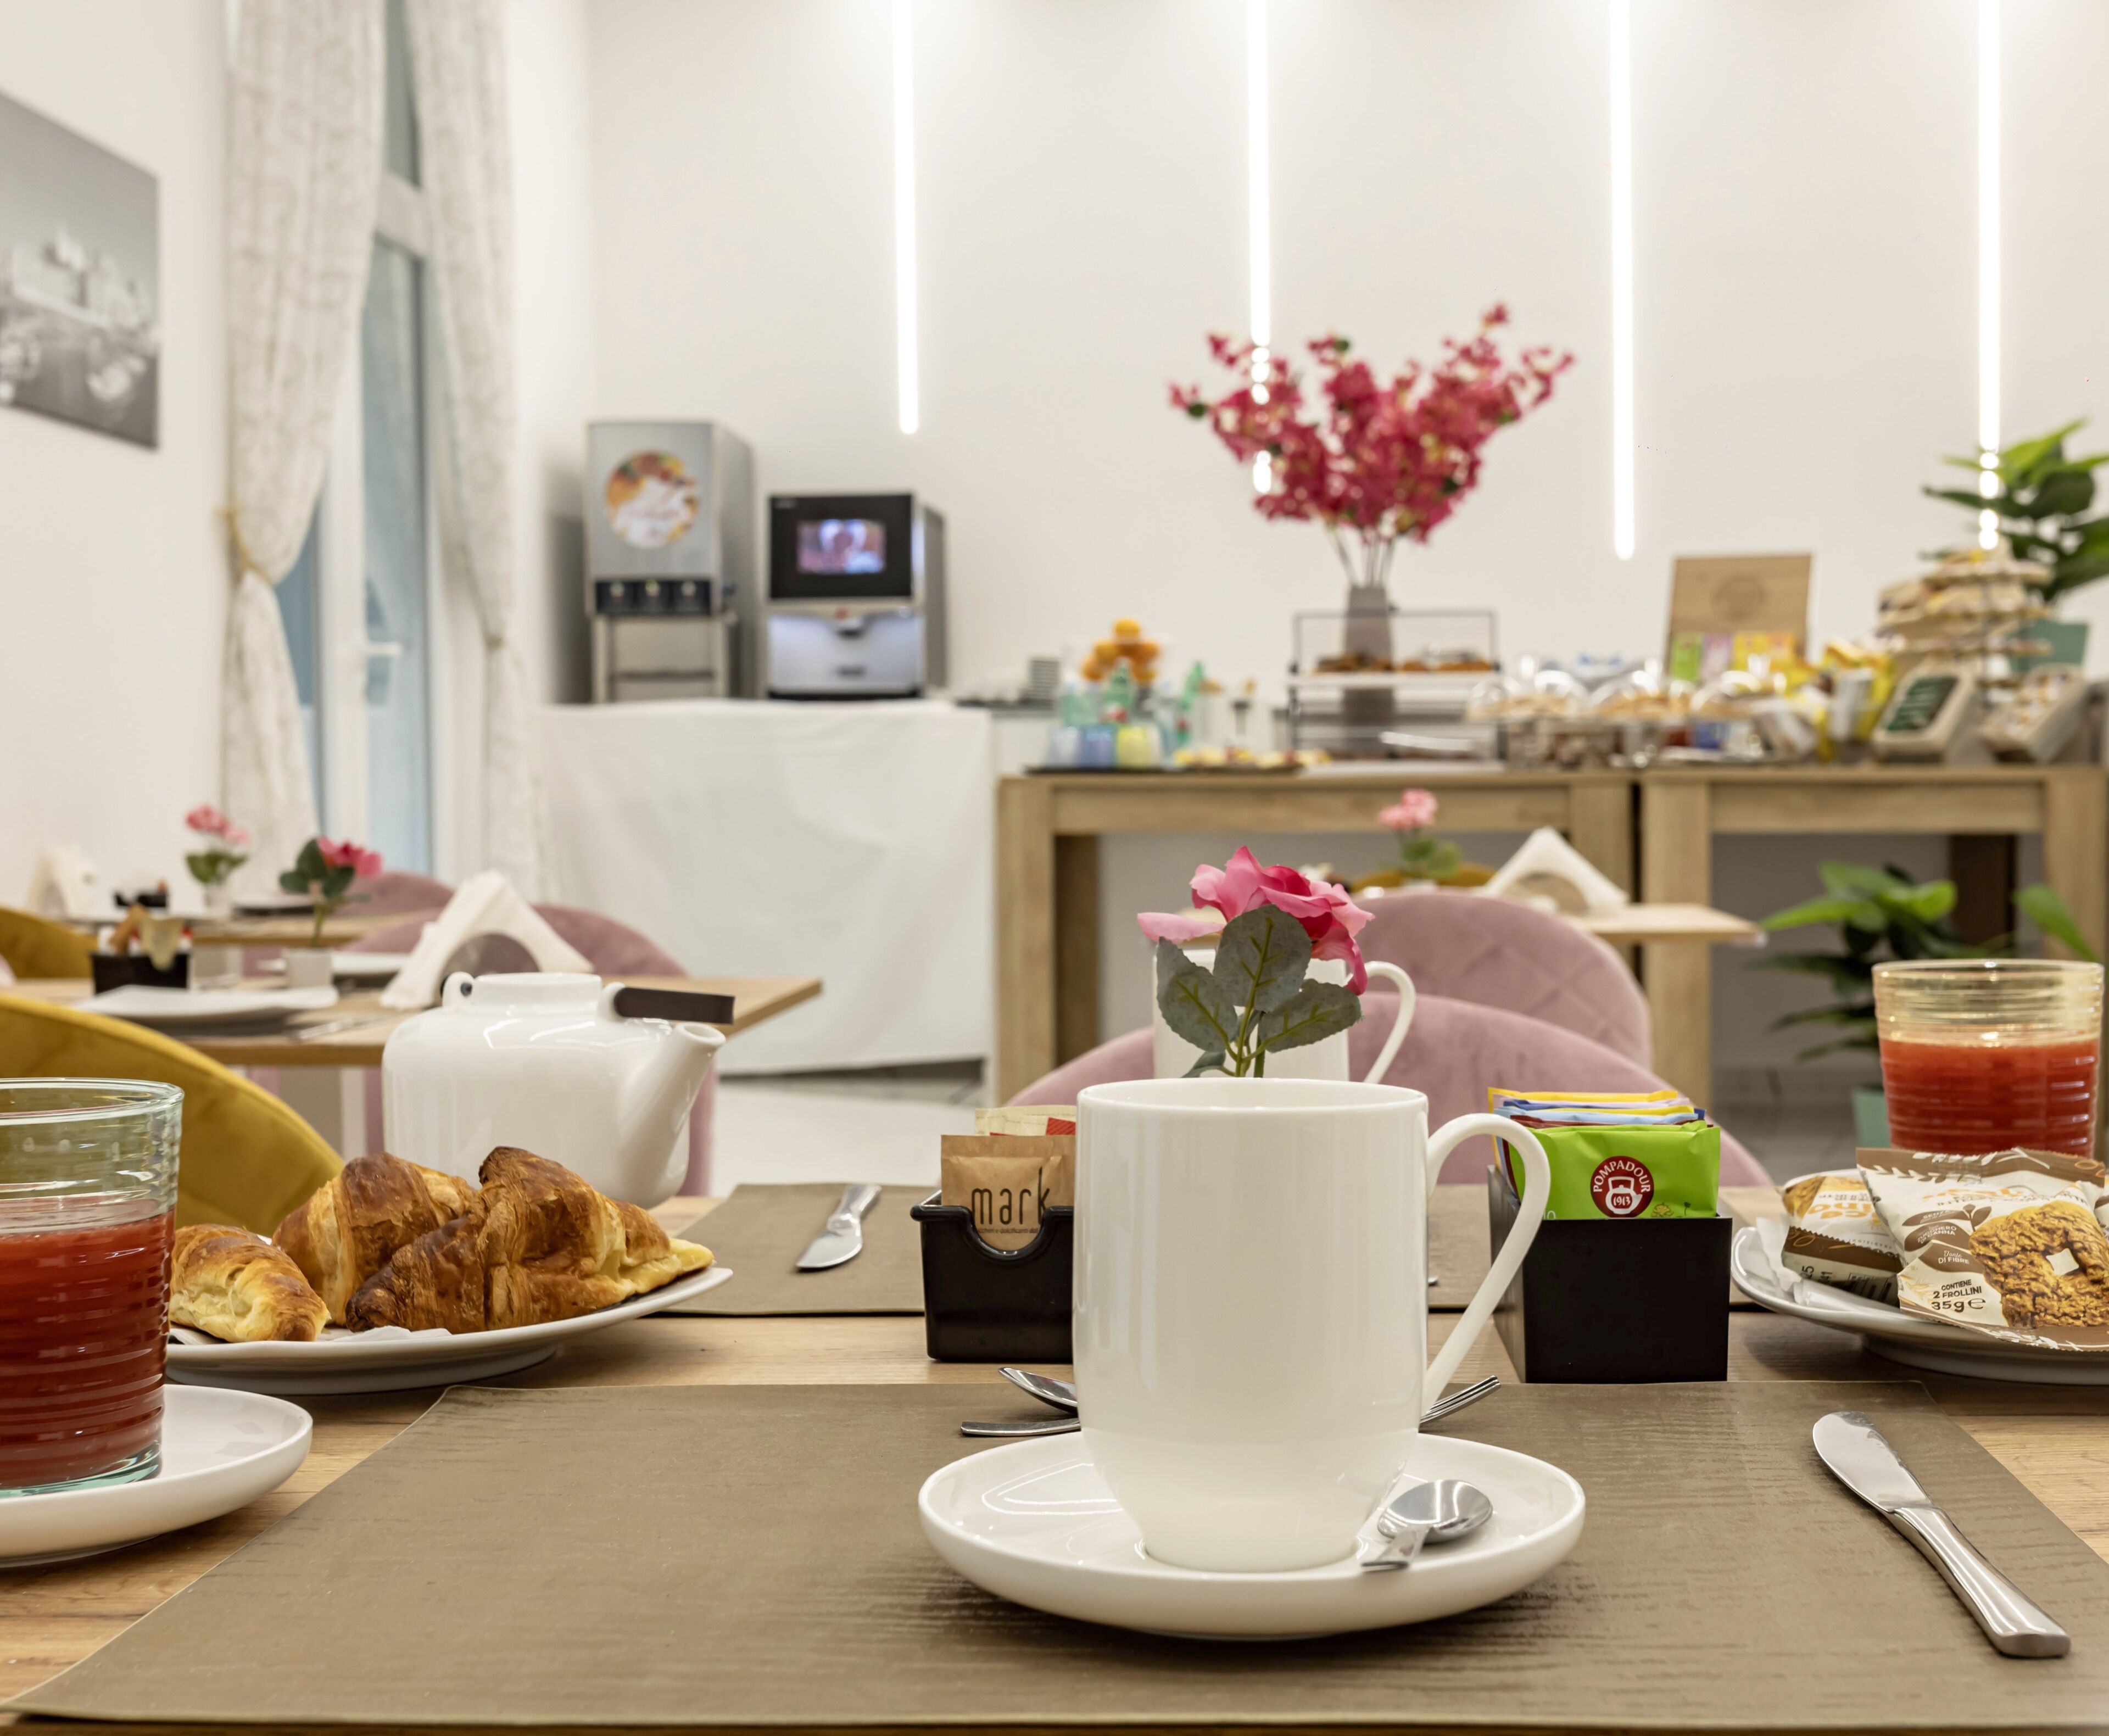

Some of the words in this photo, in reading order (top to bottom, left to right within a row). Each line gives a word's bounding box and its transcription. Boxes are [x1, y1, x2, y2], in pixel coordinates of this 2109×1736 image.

[1593, 1160, 1650, 1193] POMPADOUR
[972, 1166, 1050, 1225] mark
[1613, 1196, 1631, 1205] 1913
[1941, 1279, 1972, 1291] CONTIENE
[1933, 1291, 1940, 1299] 2
[1942, 1286, 1982, 1298] FROLLINI
